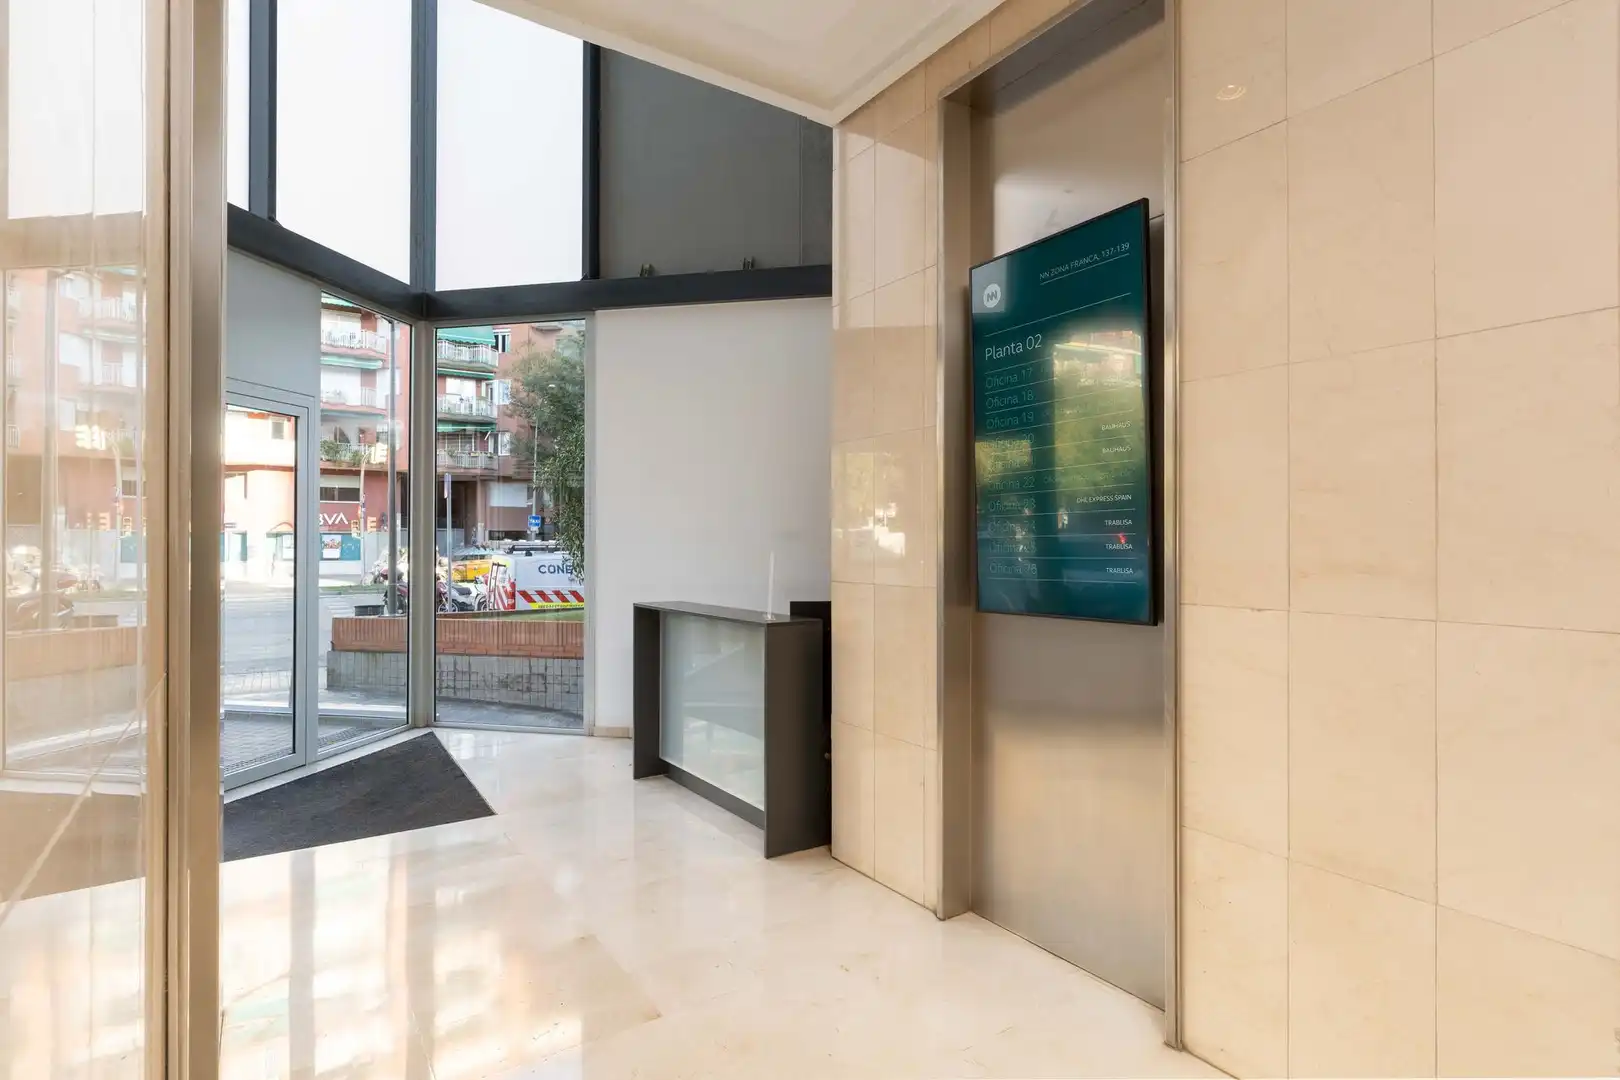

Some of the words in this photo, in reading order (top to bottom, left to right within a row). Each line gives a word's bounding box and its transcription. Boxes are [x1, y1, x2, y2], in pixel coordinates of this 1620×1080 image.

[1039, 271, 1050, 280] NN
[1050, 263, 1070, 277] ZONA
[1101, 241, 1131, 258] 137-139
[985, 341, 1024, 361] Planta
[1026, 333, 1042, 350] 02
[985, 373, 1018, 389] Oficina
[1021, 367, 1032, 379] 17
[985, 394, 1019, 409] Oficina
[1022, 389, 1034, 401] 18
[986, 415, 1019, 430] Oficina
[1022, 411, 1034, 423] 19
[1101, 419, 1132, 431] BAUHAUS
[1102, 444, 1132, 454] BAUHAUS
[1076, 496, 1088, 504] DHL
[1089, 494, 1114, 503] EXPRESS
[1114, 493, 1132, 501] SPAIN
[1104, 518, 1133, 527] TRABLISA
